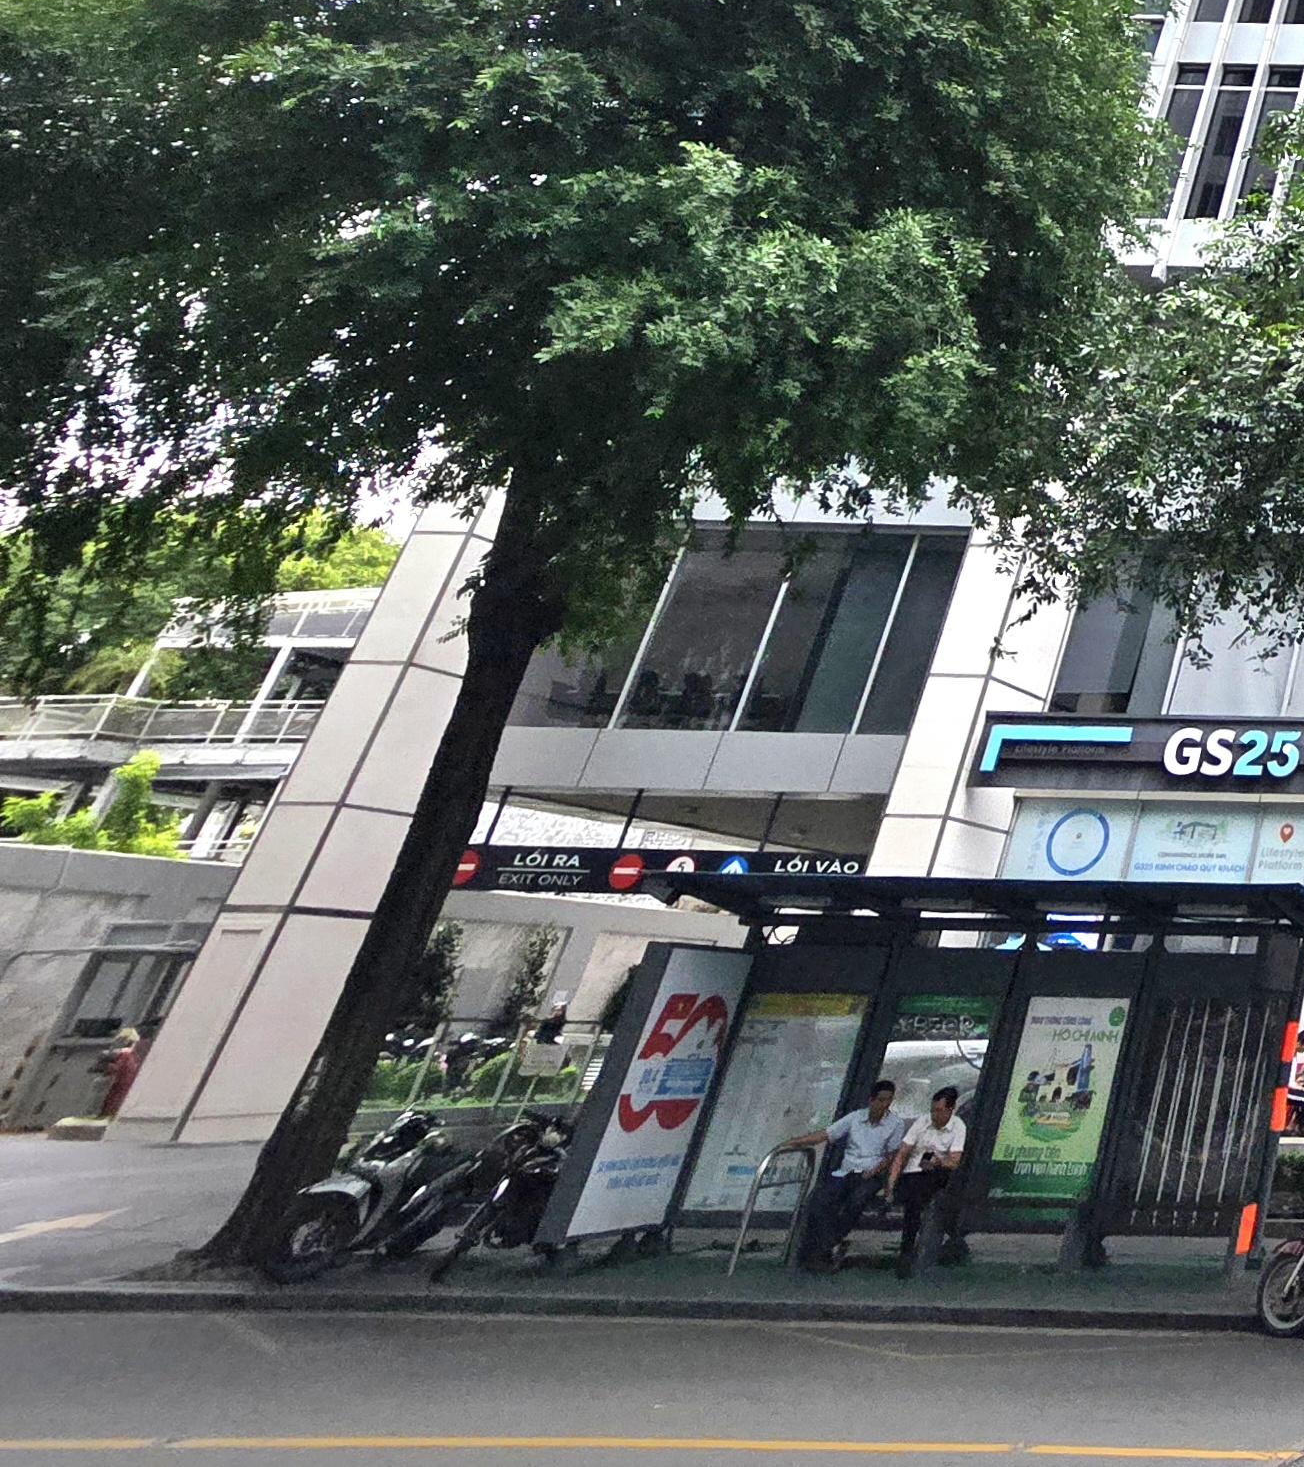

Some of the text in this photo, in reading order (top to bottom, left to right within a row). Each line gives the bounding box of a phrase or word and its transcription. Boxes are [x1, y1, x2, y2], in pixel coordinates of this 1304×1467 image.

[1163, 727, 1301, 777] GS25
[552, 854, 580, 867] RA
[498, 873, 583, 885] EXIT ONLY
